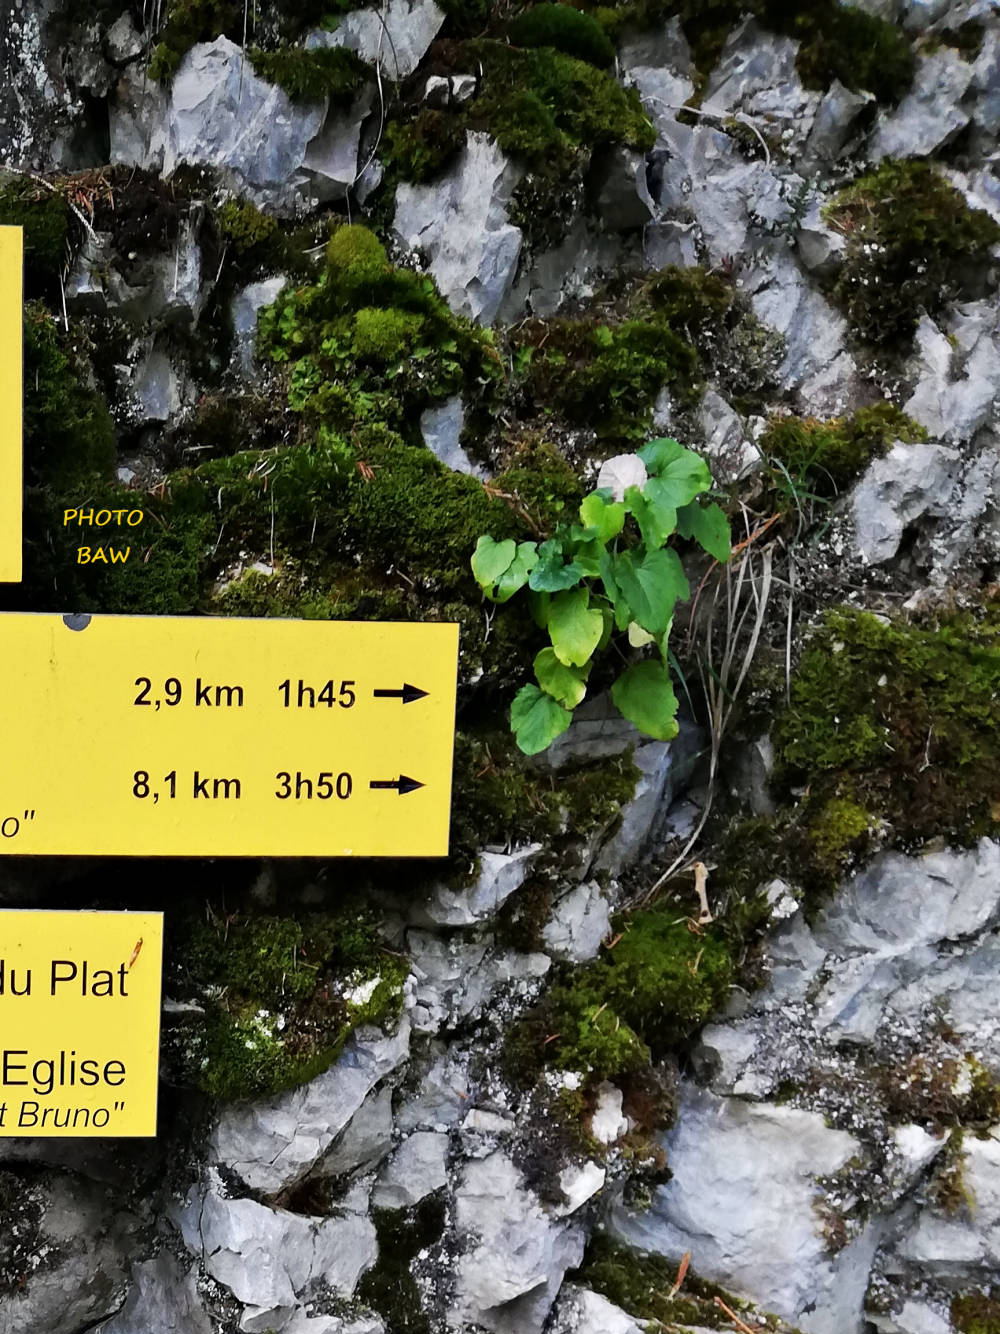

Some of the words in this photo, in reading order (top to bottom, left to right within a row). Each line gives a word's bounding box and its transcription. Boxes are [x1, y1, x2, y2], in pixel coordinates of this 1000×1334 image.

[133, 676, 182, 712] 2,9
[195, 677, 244, 707] km
[278, 679, 356, 709] 1h45
[132, 770, 177, 804] 8,1
[193, 770, 241, 799] km
[275, 771, 353, 800] 3h50
[50, 960, 129, 997] Plat
[2, 1050, 126, 1096] Eglise
[17, 1101, 125, 1128] Bruno"
